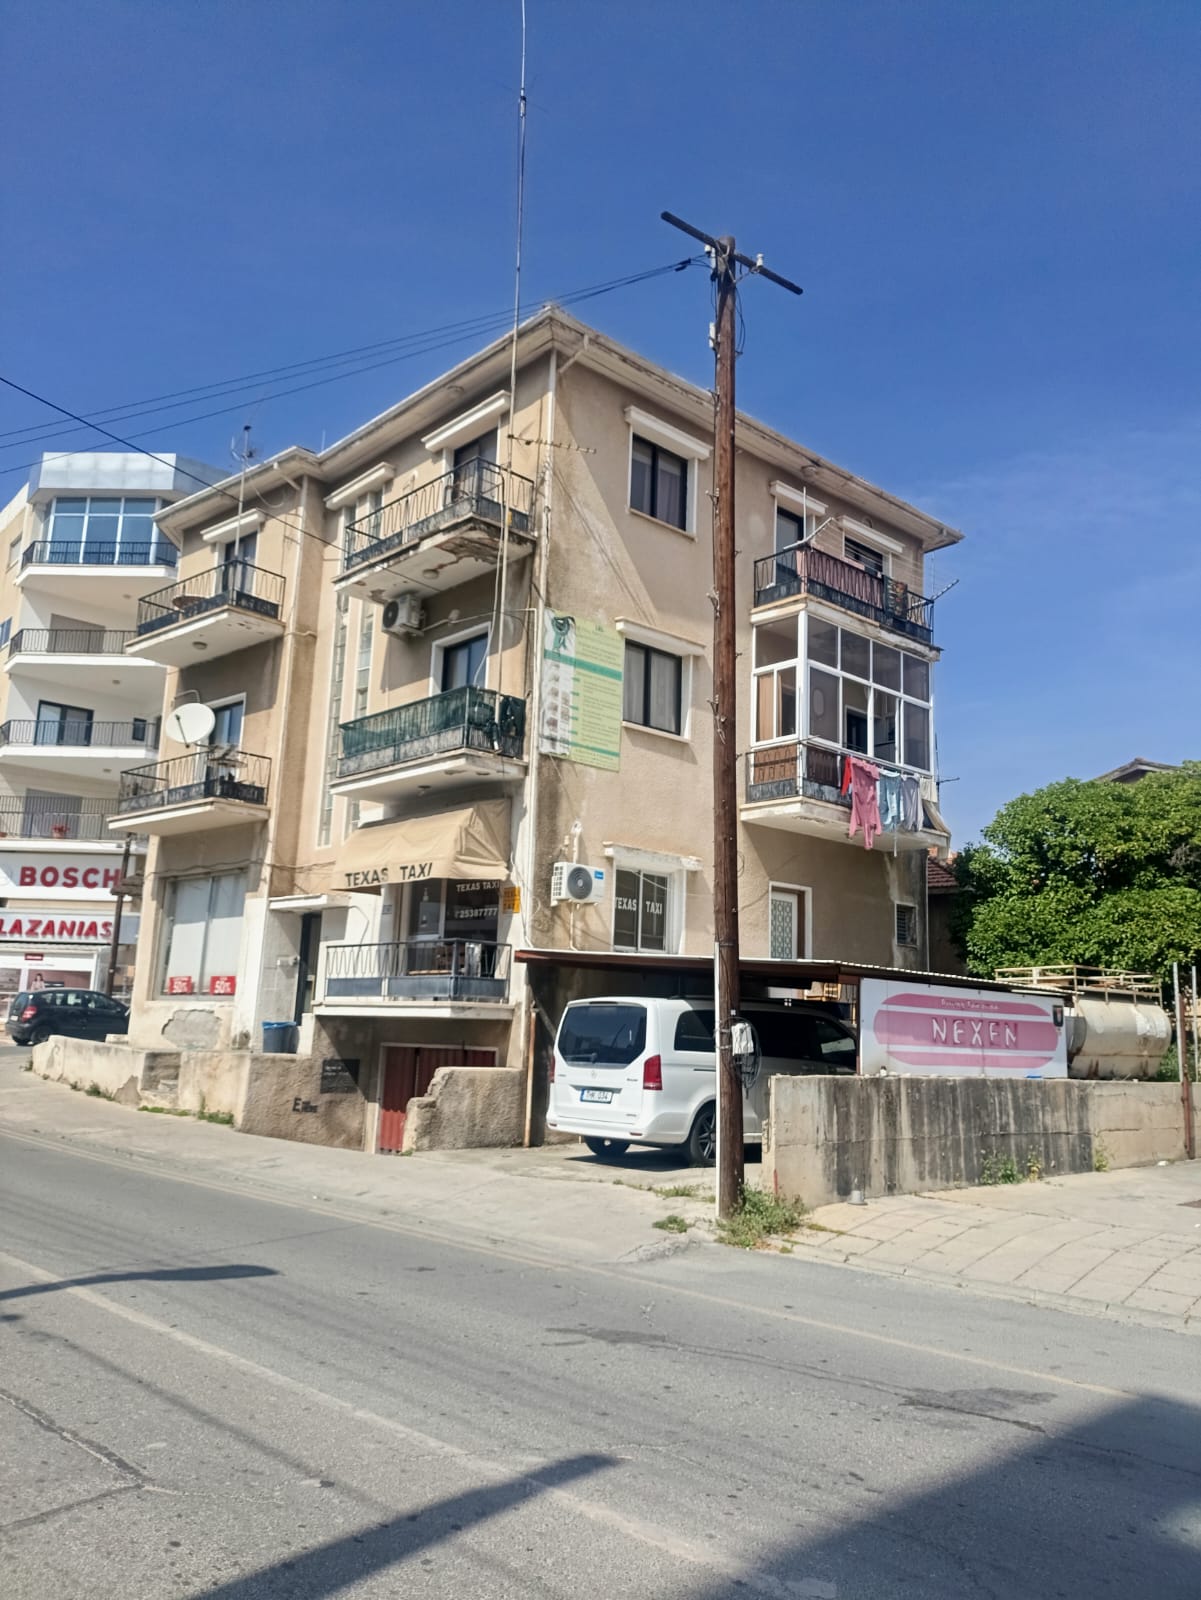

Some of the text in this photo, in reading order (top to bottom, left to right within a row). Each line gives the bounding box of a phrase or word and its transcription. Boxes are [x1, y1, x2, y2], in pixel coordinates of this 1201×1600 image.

[19, 866, 122, 889] BOSCH
[345, 862, 433, 887] TEXAS TAXI
[456, 880, 500, 892] TEXAS TAXI
[645, 900, 663, 915] TAXI
[931, 1017, 1019, 1049] NEXEN
